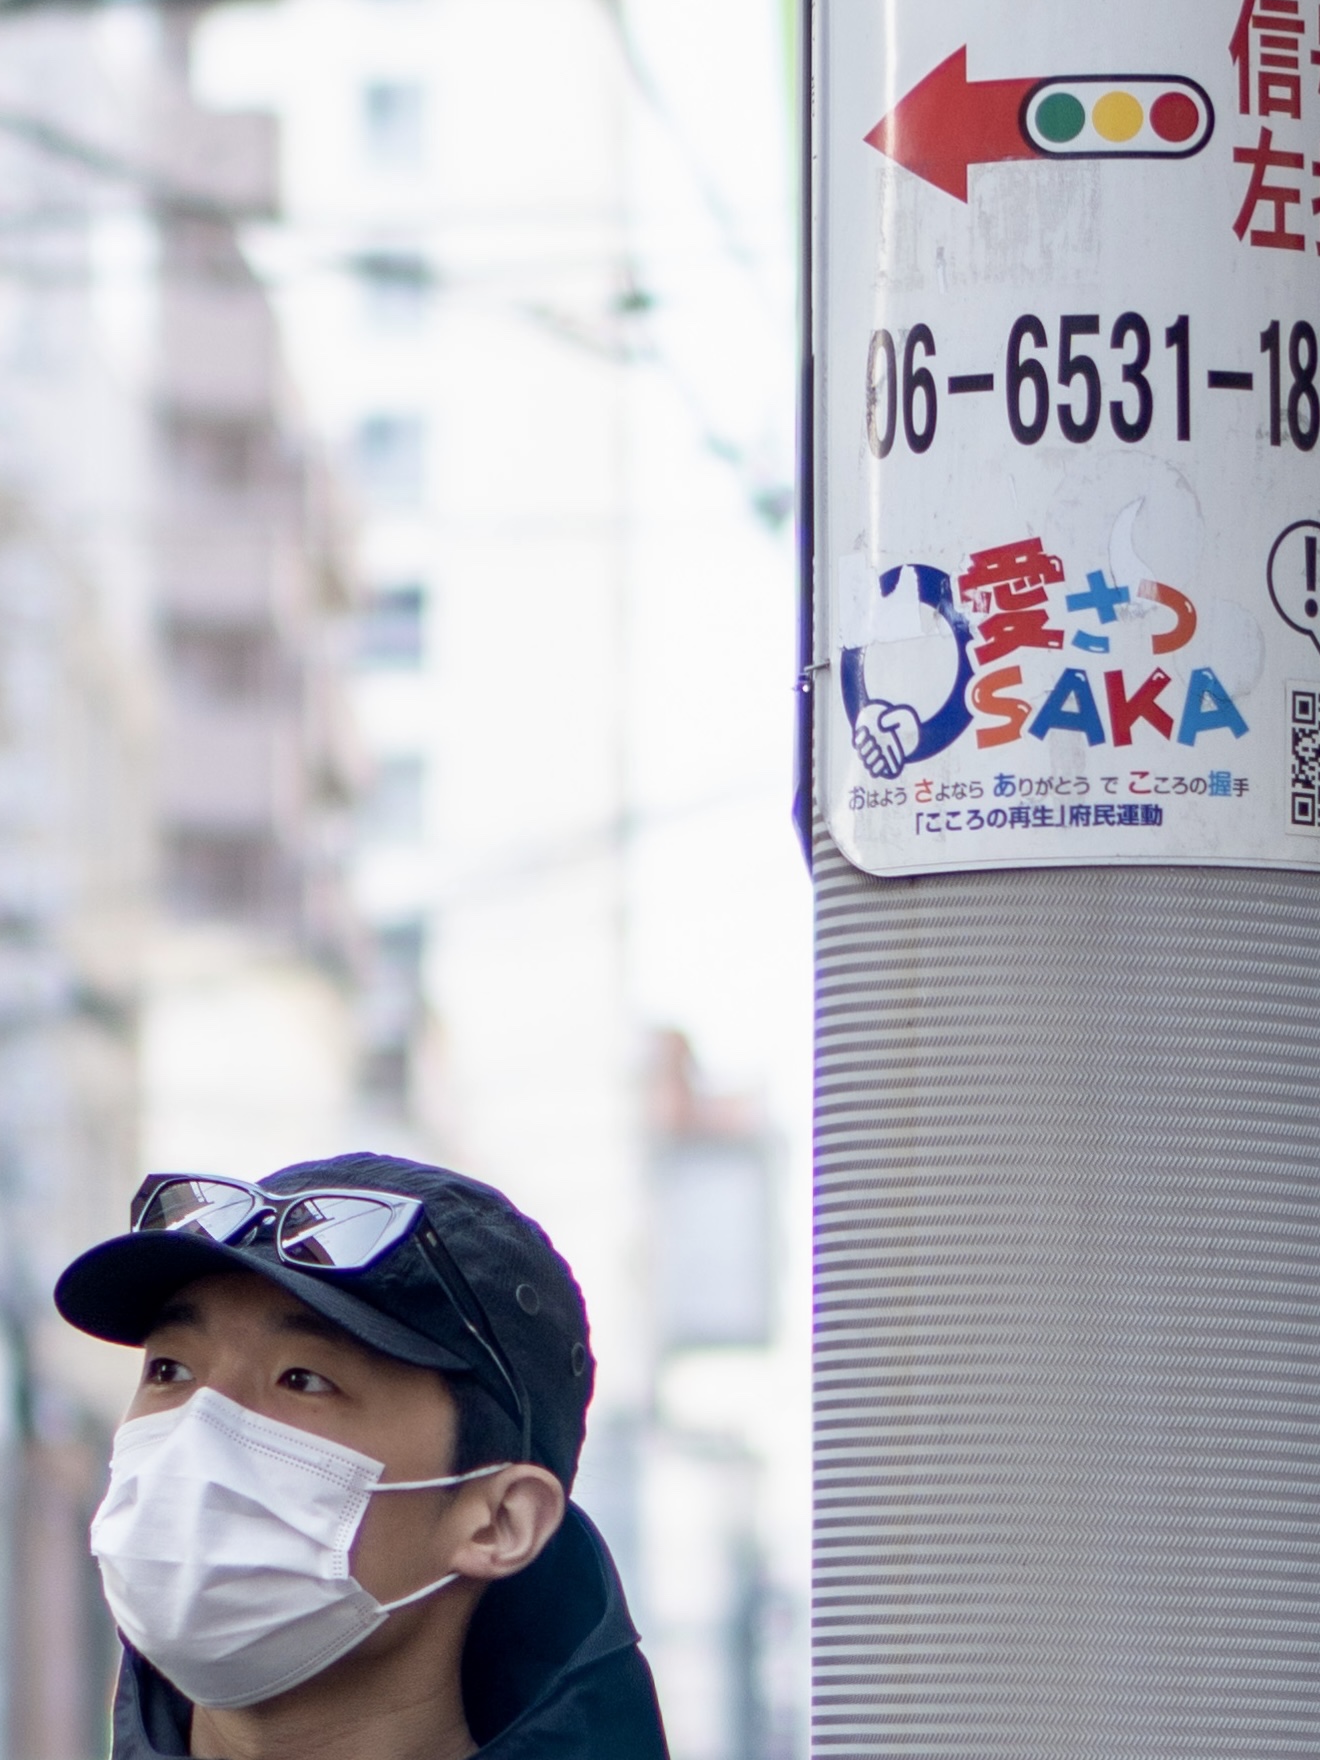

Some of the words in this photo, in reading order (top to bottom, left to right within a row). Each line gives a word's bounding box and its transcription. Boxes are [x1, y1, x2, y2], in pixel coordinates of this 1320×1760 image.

[957, 537, 1199, 665] 愛さつ
[913, 777, 985, 804] さよなら
[992, 772, 1091, 801] ありがとう
[1128, 769, 1250, 798] こころの握手
[915, 802, 1164, 836] 「こころの再生」府民運動
